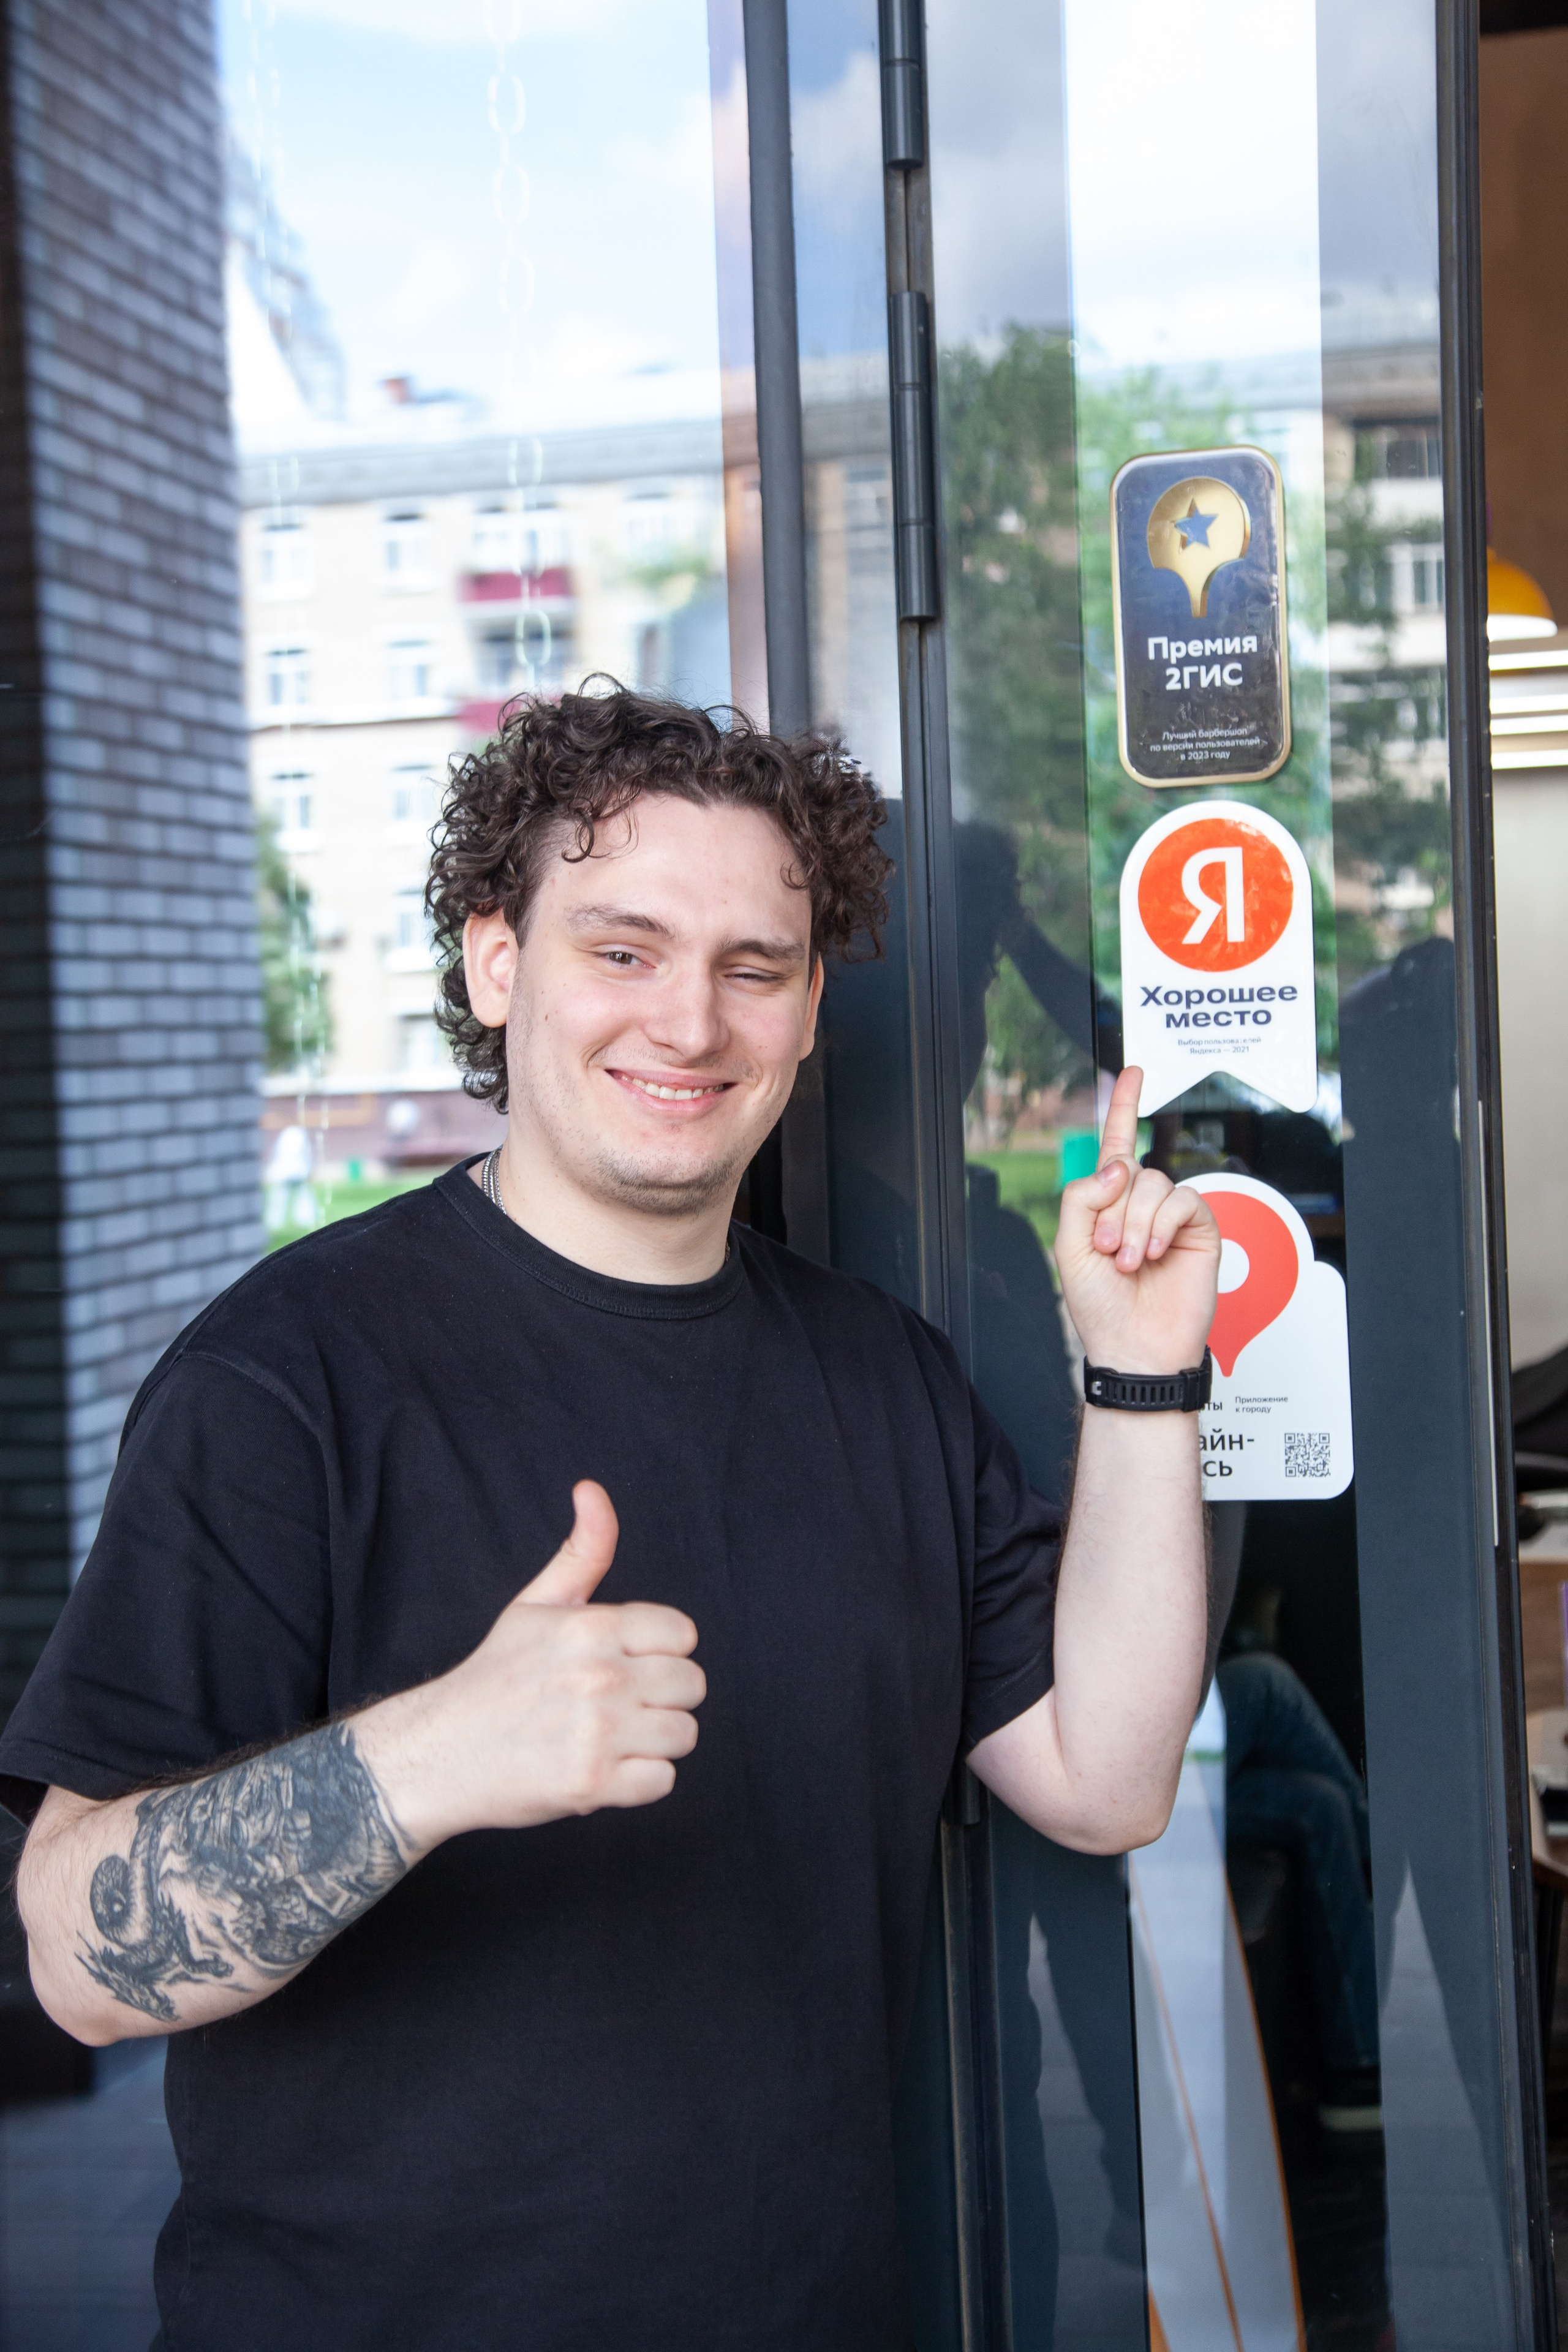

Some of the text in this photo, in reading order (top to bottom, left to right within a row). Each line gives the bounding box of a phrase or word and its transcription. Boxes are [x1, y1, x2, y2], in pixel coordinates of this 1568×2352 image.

[1147, 635, 1257, 664] Премия
[1166, 663, 1243, 690] 2ГИС
[1162, 728, 1248, 741] Лучший барбершоп
[1163, 742, 1194, 752] версии
[1196, 736, 1260, 749] пользователей
[1188, 752, 1209, 760] 2023
[1211, 751, 1231, 760] году
[1182, 846, 1245, 944] Я
[1140, 986, 1298, 1009] Хорошее
[1166, 1010, 1272, 1028] место
[1242, 1406, 1272, 1414] городу
